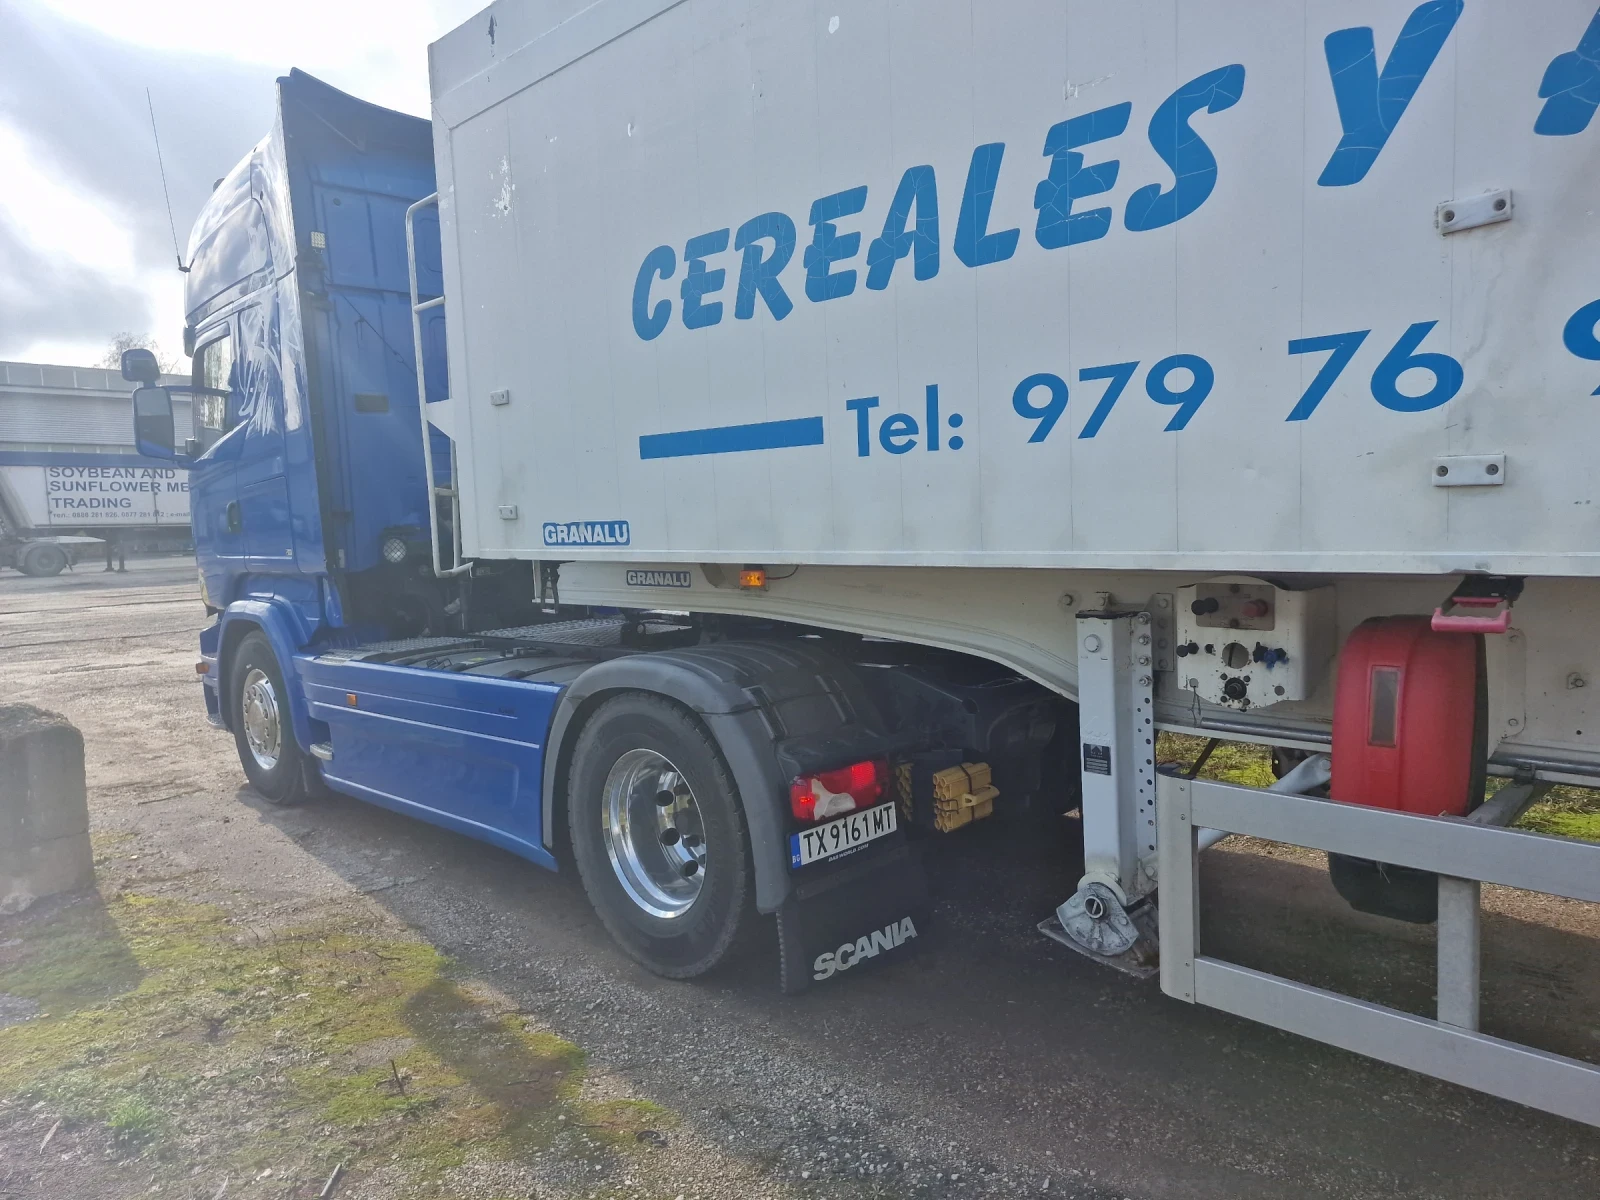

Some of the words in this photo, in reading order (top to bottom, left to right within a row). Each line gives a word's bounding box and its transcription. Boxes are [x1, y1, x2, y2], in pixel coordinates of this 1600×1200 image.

[633, 64, 1245, 340] CEREALES
[1318, 0, 1464, 186] Y
[847, 385, 964, 457] Tel:
[1013, 354, 1214, 442] 979
[1286, 321, 1463, 421] 76
[49, 466, 136, 479] SOYBEAN
[140, 468, 176, 479] AND
[50, 480, 162, 492] SUNFLOWER
[51, 497, 132, 509] TRADING
[544, 523, 627, 543] GRANALU
[627, 572, 690, 586] GRANALU
[792, 853, 801, 864] BG
[813, 916, 918, 981] SCANIA
